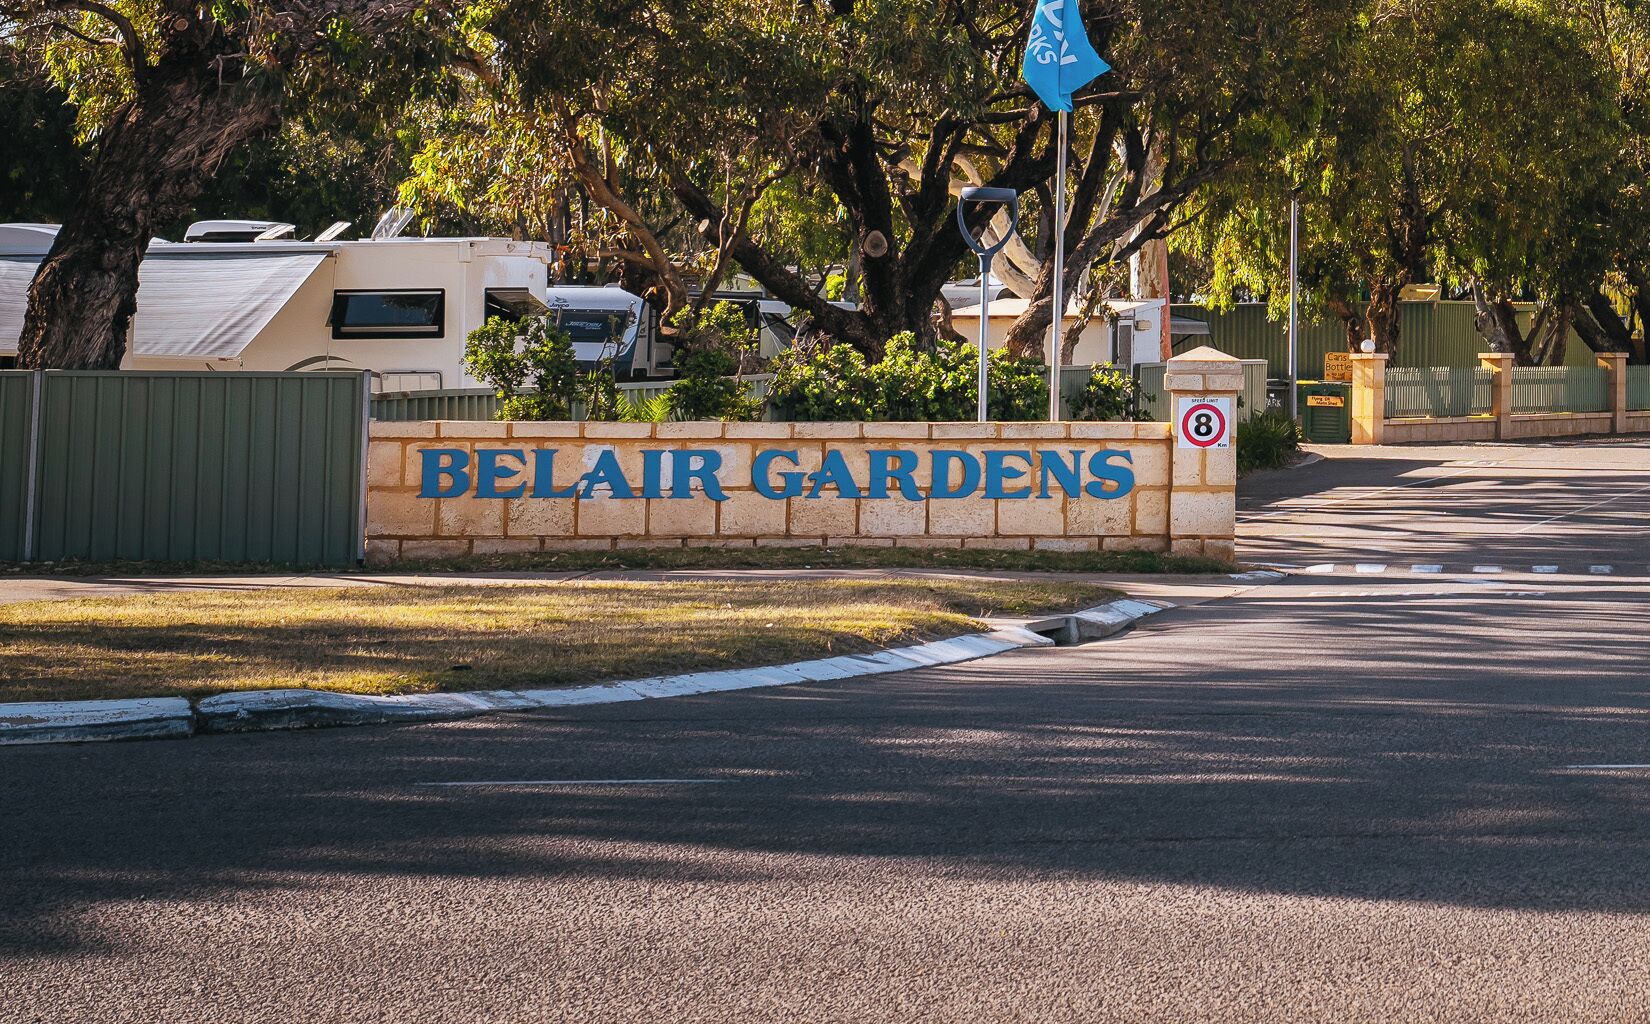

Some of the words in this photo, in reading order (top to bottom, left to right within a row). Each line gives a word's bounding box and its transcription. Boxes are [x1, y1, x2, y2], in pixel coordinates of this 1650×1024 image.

[1327, 352, 1347, 362] Cans
[1194, 413, 1213, 436] 8
[420, 449, 729, 501] BELAIR
[751, 449, 1135, 501] GARDENS
